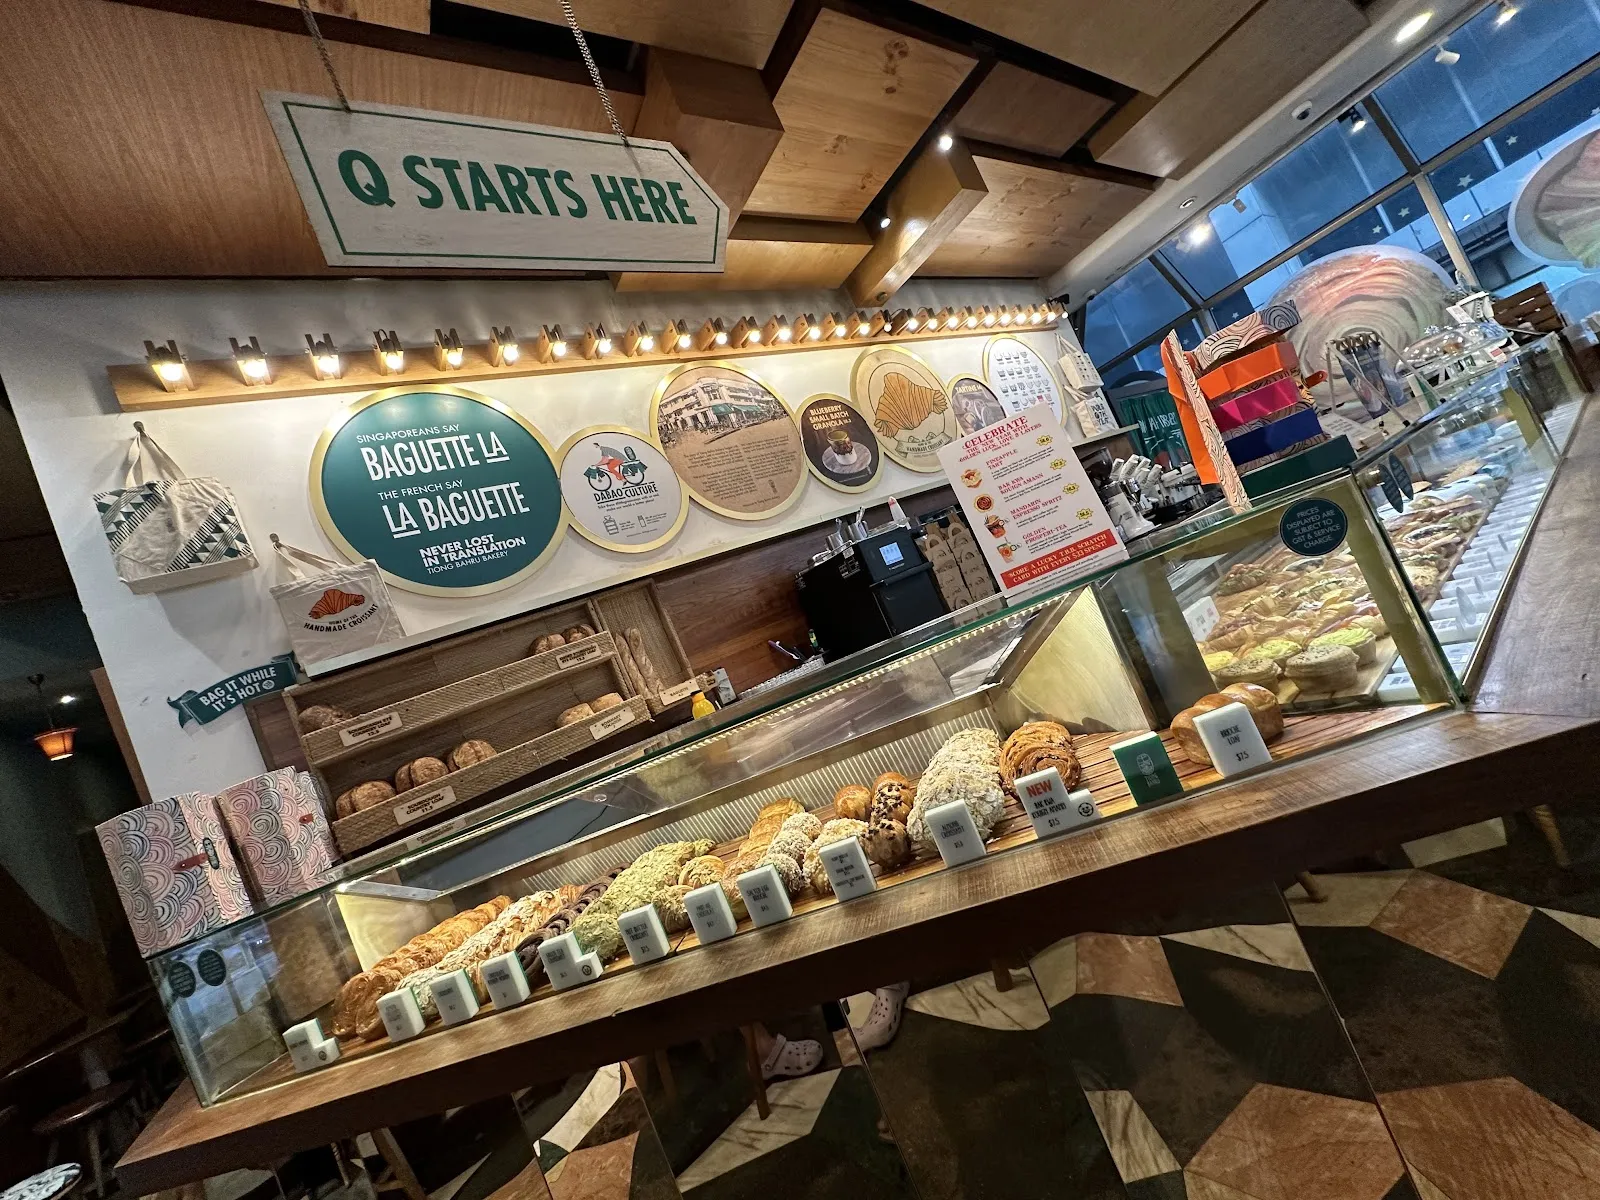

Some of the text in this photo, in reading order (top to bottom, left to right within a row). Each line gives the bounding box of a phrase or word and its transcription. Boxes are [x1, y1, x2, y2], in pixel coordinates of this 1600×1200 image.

[338, 149, 698, 225] Q STARTS HERE
[809, 411, 849, 424] SMALL BATCH
[810, 405, 842, 416] BLUEBERRY
[356, 424, 461, 444] SINGAPOREANS SAY
[813, 420, 844, 431] GRANOLA
[962, 416, 1029, 449] CELEBRATE
[959, 451, 981, 462] GOLDEN
[1000, 436, 1015, 445] LOVE
[966, 424, 1029, 454] THE NEW YEAR WITH
[360, 431, 508, 481] BAGUETTE LA
[986, 449, 1019, 466] PINEAPPLE
[988, 461, 1003, 470] TART
[1023, 473, 1044, 485] AMANN
[378, 480, 464, 501] THE FRENCH SAY
[594, 489, 624, 502] DABAO
[625, 484, 659, 498] CULTURE
[382, 482, 531, 533] LA BAGUETTE
[1010, 499, 1042, 515] MANDARIN
[1013, 505, 1041, 520] ESPRESSO
[1042, 496, 1063, 507] SPRITZ
[1296, 507, 1320, 518] PRICES
[1286, 509, 1336, 530] DISPLAYED ARE
[1294, 518, 1333, 536] SUBJECT TO
[1022, 526, 1047, 540] GOLDEN
[1292, 536, 1306, 545] GST
[1314, 524, 1341, 538] SERVICE
[1304, 534, 1333, 549] CHARGE
[419, 534, 495, 558] NEVER LOST
[423, 537, 527, 568] IN TRANSLATION
[1009, 566, 1030, 577] SCORE
[1037, 555, 1058, 567] LUCKY
[1077, 533, 1107, 550] SCRATCH
[427, 550, 509, 575] TIONG BAHRU BAKERY
[1013, 574, 1031, 583] CARD
[1032, 566, 1050, 576] WITH
[1051, 556, 1072, 568] EVERY
[1085, 541, 1108, 554] SPENT!
[304, 603, 379, 633] HANDMADE CROISSANT
[199, 667, 277, 706] BAG IT WHILE
[212, 682, 261, 712] IT'S HOT
[352, 721, 391, 737] COUNTRY LOAF
[1227, 735, 1241, 746] LOAF
[1026, 779, 1053, 798] NEW
[407, 796, 445, 815] COUNTRY LOAF
